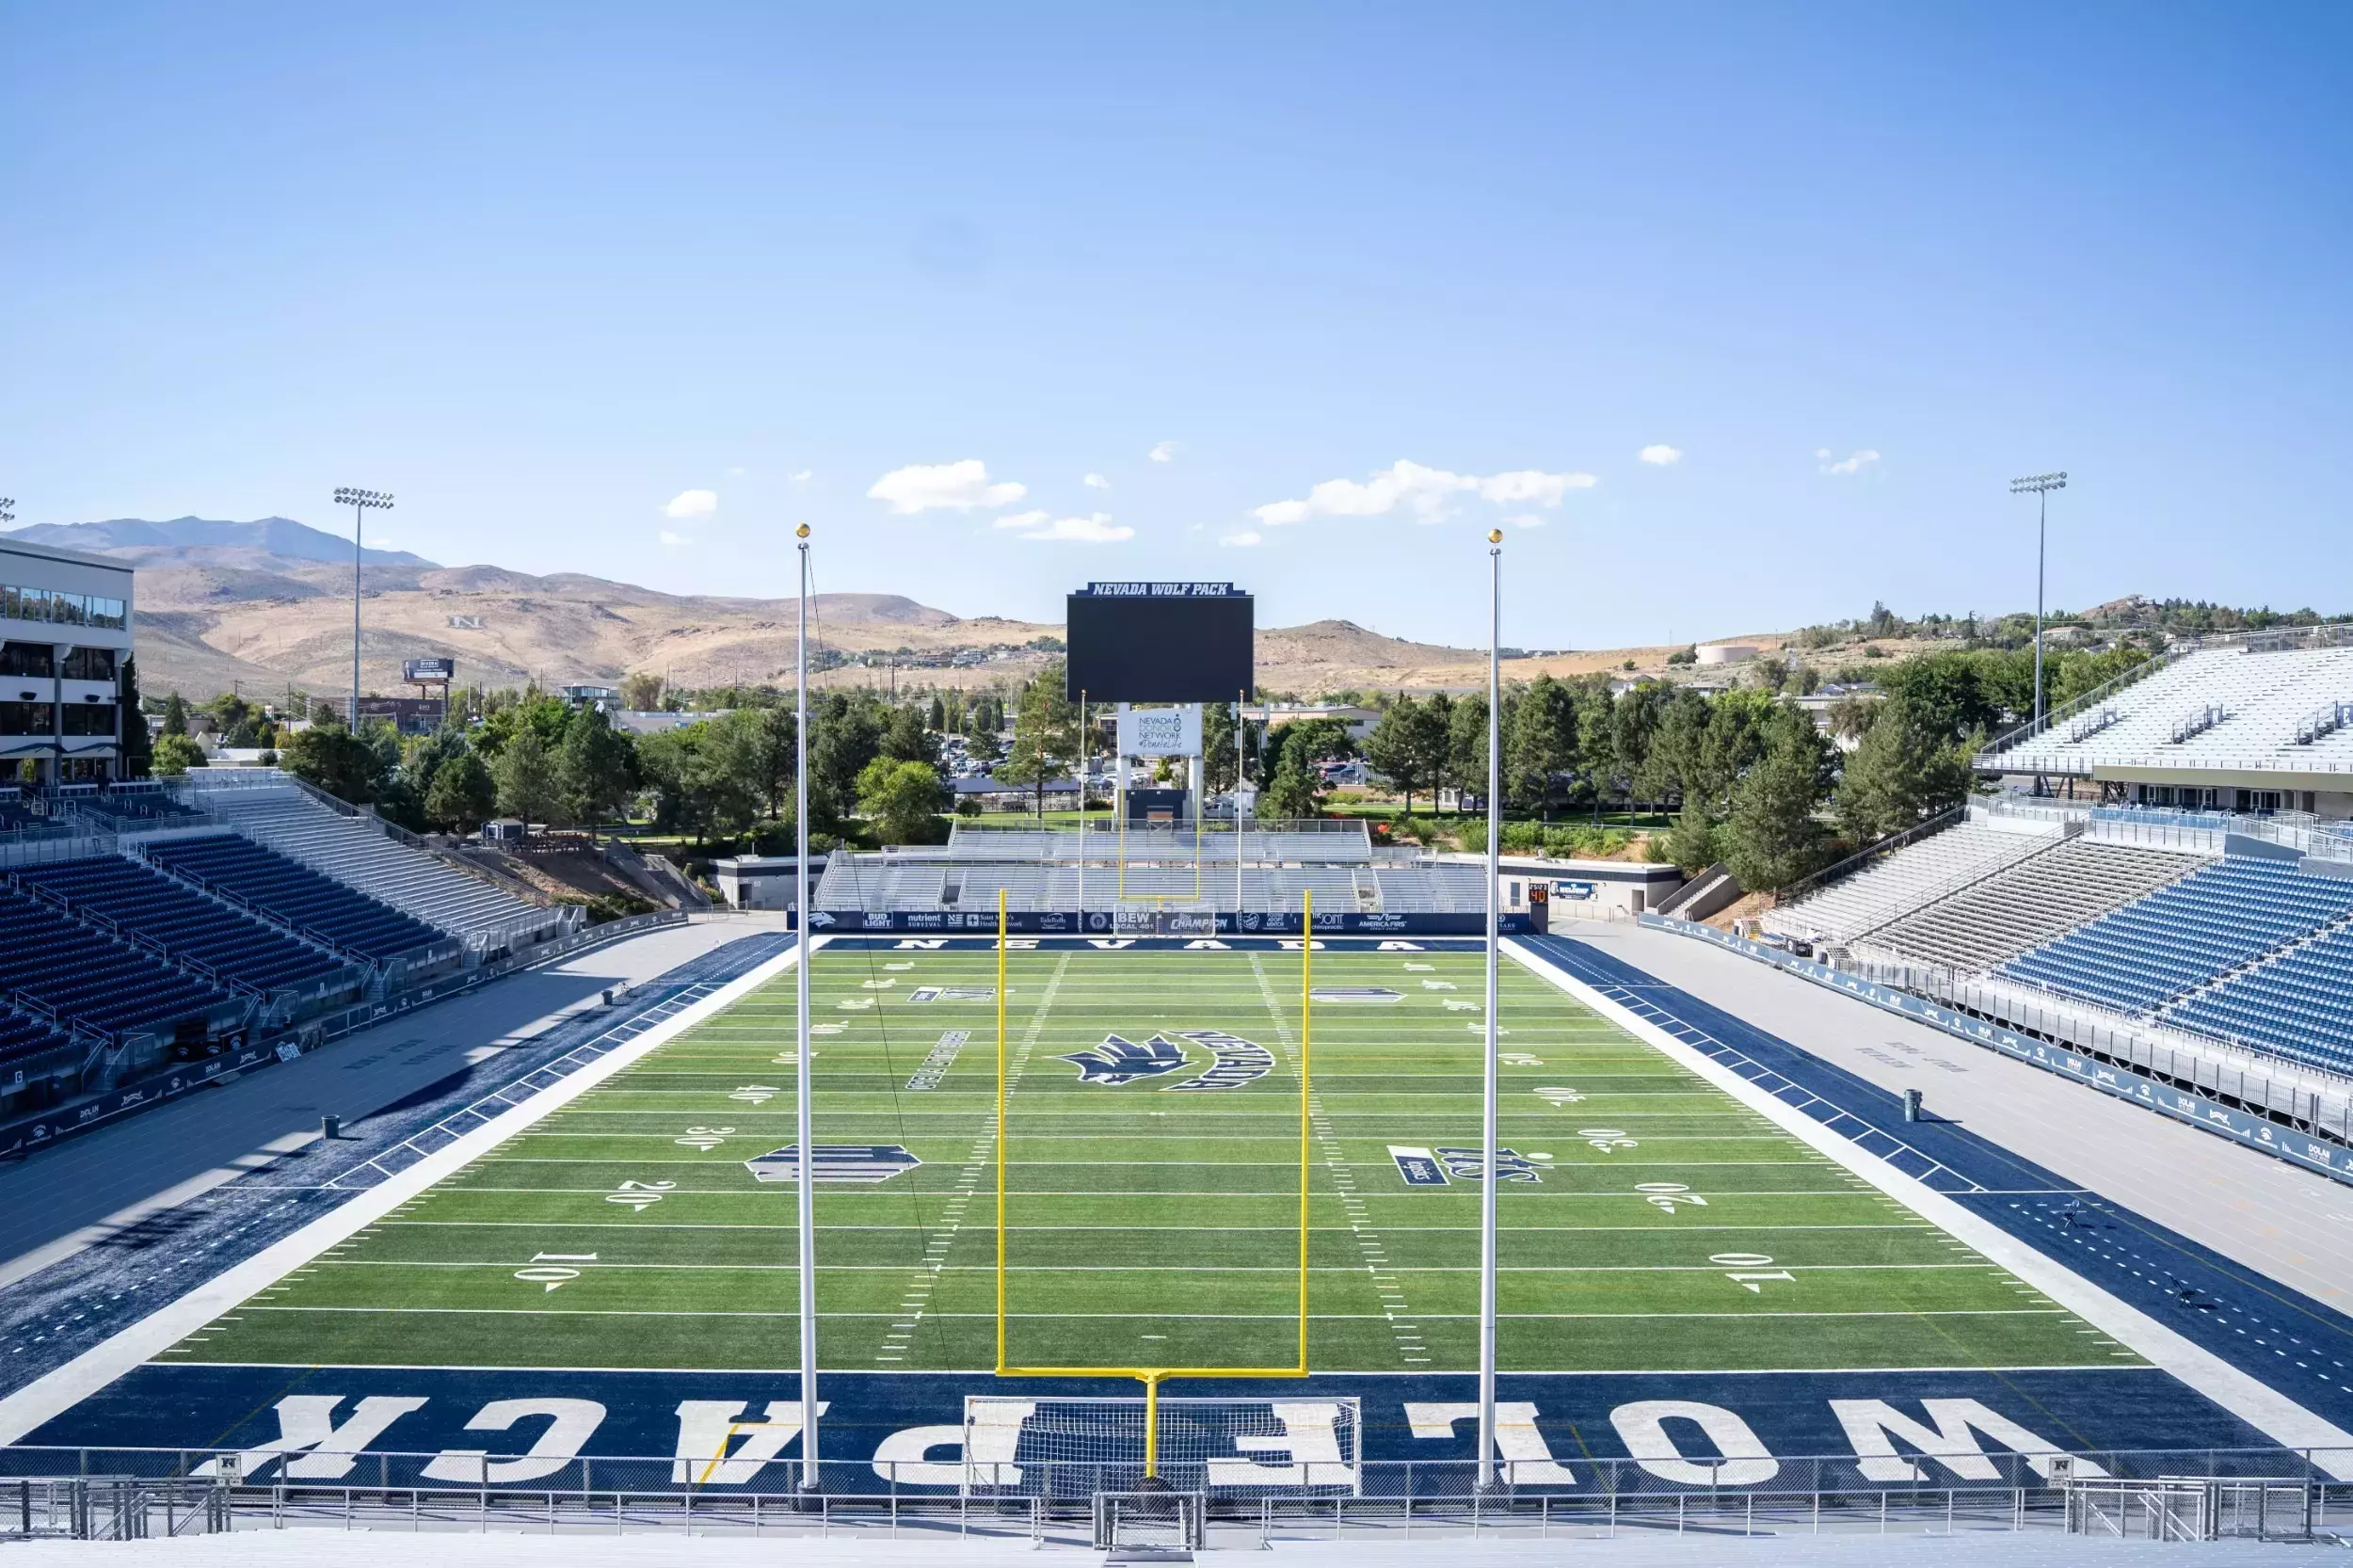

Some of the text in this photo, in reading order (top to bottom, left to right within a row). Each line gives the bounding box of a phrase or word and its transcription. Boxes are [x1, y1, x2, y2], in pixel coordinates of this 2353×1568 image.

[1093, 583, 1228, 596] NEVADA WOLF PACK
[2343, 707, 2351, 724] E
[1530, 890, 1545, 903] 40
[907, 913, 941, 922] nutrient
[995, 914, 1015, 922] My's
[893, 939, 1425, 950] NEVADA
[1158, 1030, 1276, 1091] NEVADA
[728, 1084, 780, 1099] 40
[1533, 1087, 1586, 1103] 40
[675, 1127, 735, 1145] 30
[1577, 1129, 1638, 1150] 30
[2308, 1143, 2330, 1160] DOLAN
[605, 1180, 677, 1204] 20
[1634, 1182, 1708, 1208] 20
[513, 1251, 598, 1281] 10
[1709, 1253, 1796, 1282] 10
[188, 1394, 2111, 1487] WOLF PACK
